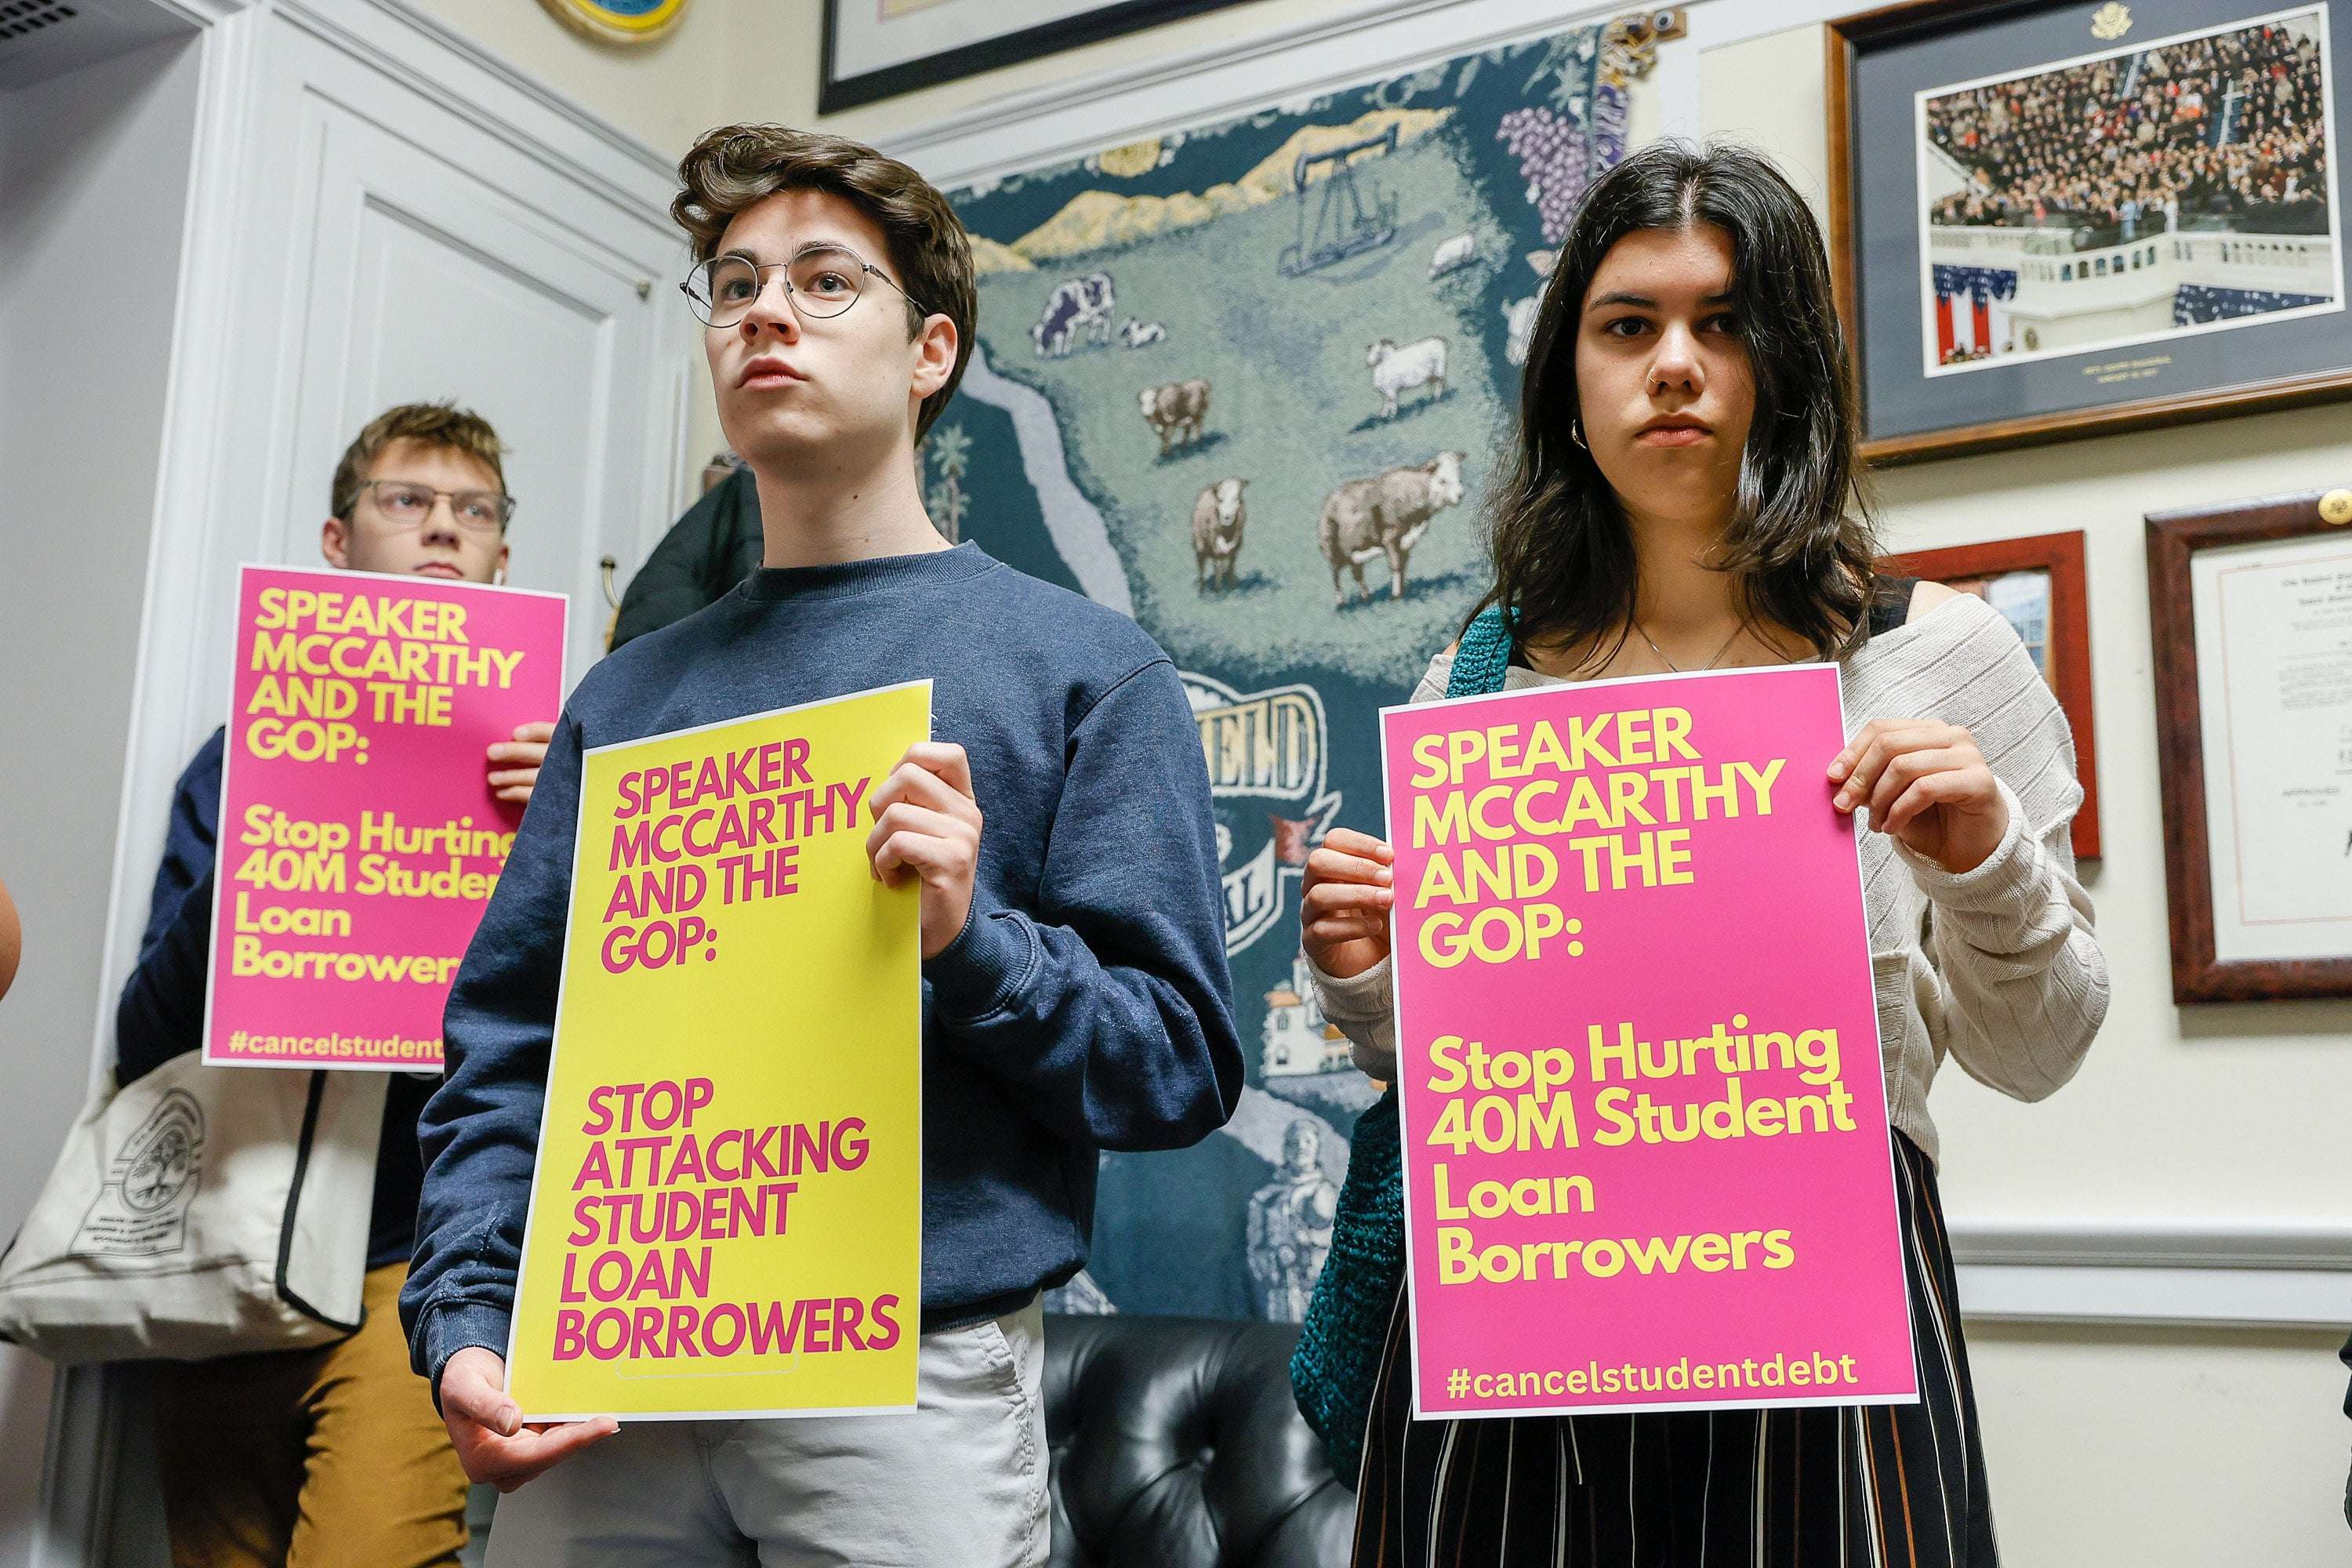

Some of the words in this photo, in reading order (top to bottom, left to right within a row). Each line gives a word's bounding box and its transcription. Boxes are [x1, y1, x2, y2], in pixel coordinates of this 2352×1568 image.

[255, 588, 469, 643] SPEAKER
[251, 630, 524, 688] MCCARTHY
[247, 675, 358, 719] AND
[366, 681, 453, 726] THE
[246, 717, 369, 764] GOP:
[1410, 706, 1701, 789] SPEAKER
[614, 738, 813, 819] SPEAKER
[1412, 758, 1787, 849] MCCARTHY
[240, 805, 350, 860] Stop
[609, 777, 869, 871] MCCARTHY
[234, 850, 347, 895] 40M
[604, 864, 707, 923] AND
[717, 845, 800, 905] THE
[1414, 842, 1559, 909] AND
[1568, 828, 1695, 891] THE
[234, 891, 351, 936] Loan
[1417, 902, 1584, 969] GOP:
[601, 916, 717, 974] GOP:
[1427, 1036, 1575, 1105] Stop
[1588, 1013, 1842, 1084] Hurting
[582, 1077, 713, 1136] STOP
[1427, 1090, 1580, 1156] 40M
[1593, 1079, 1857, 1146] Student
[572, 1117, 869, 1191] ATTACKING
[568, 1182, 798, 1247] STUDENT
[1433, 1163, 1595, 1221] Loan
[561, 1246, 713, 1303] LOAN
[1437, 1227, 1795, 1285] Borrowers
[553, 1294, 901, 1362] BORROWERS
[1447, 1351, 1858, 1399] #cancelstudentdebt
